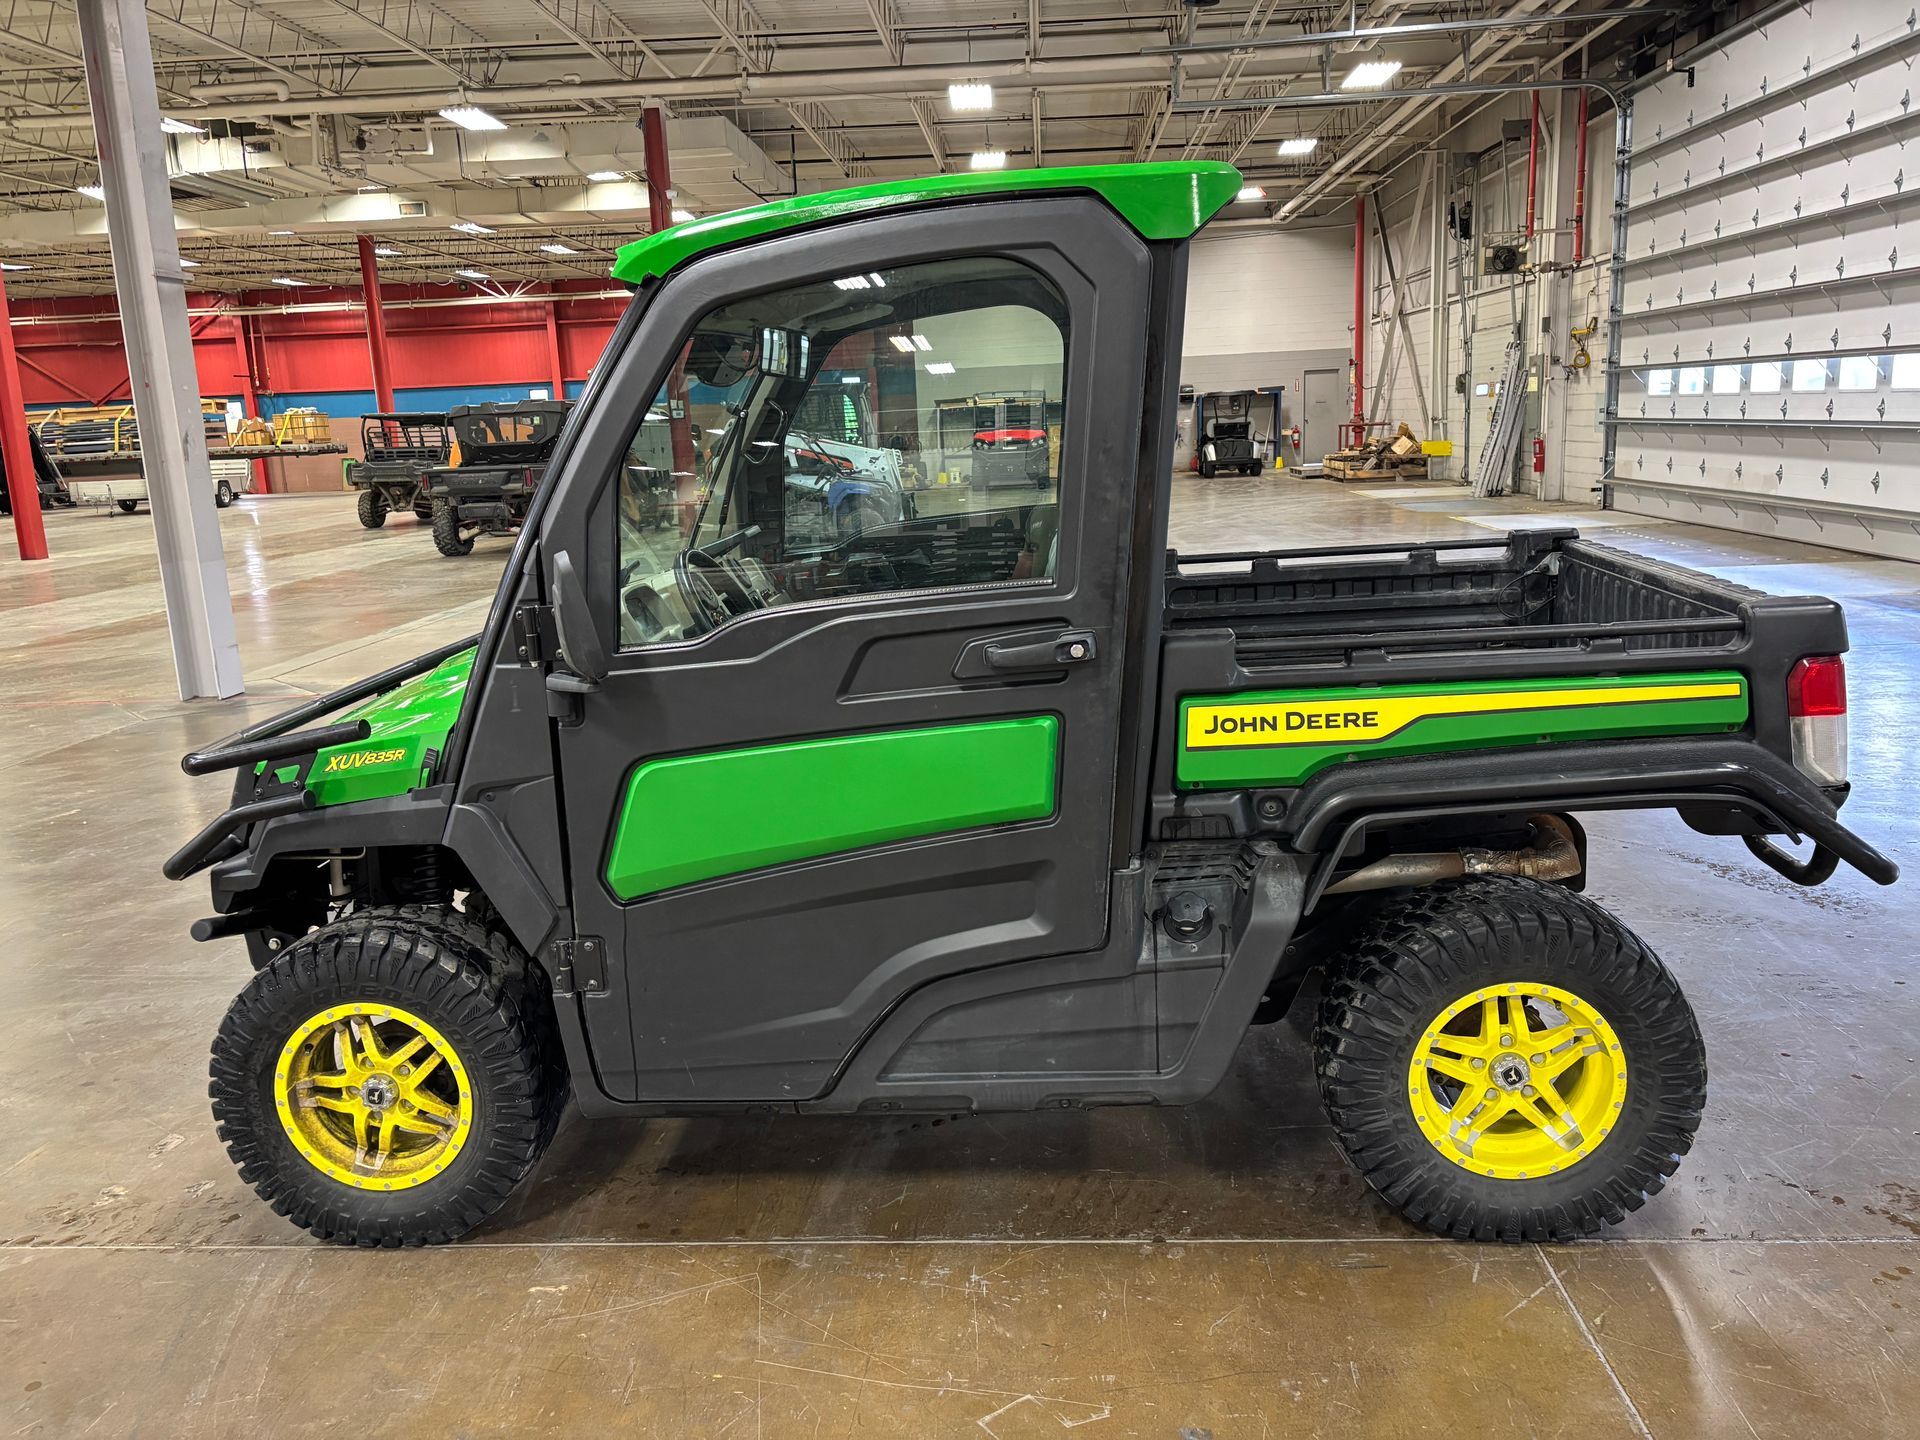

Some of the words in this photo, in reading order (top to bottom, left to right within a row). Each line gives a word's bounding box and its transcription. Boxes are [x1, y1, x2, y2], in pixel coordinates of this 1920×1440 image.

[1204, 715, 1278, 735] JOHN
[1285, 711, 1379, 731] DEERE
[323, 748, 406, 772] XUV835R
